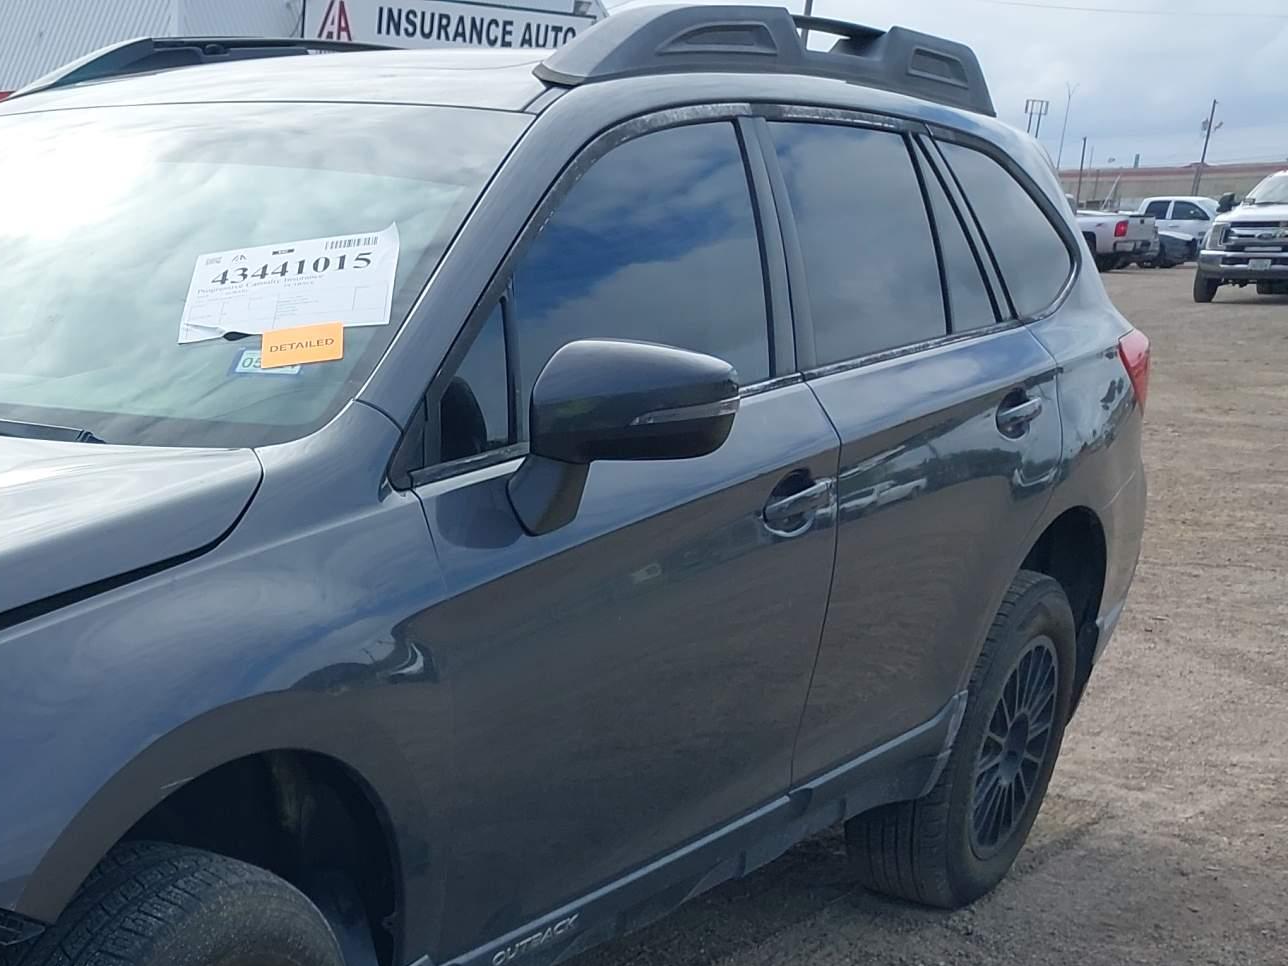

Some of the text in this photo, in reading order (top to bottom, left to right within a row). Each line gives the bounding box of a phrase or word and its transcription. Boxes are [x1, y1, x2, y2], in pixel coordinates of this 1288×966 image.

[376, 6, 513, 48] INSURANCE
[520, 22, 576, 48] AUTO
[211, 252, 373, 285] 43441015
[269, 337, 335, 354] DETAILED
[492, 913, 579, 966] OUTBACK
